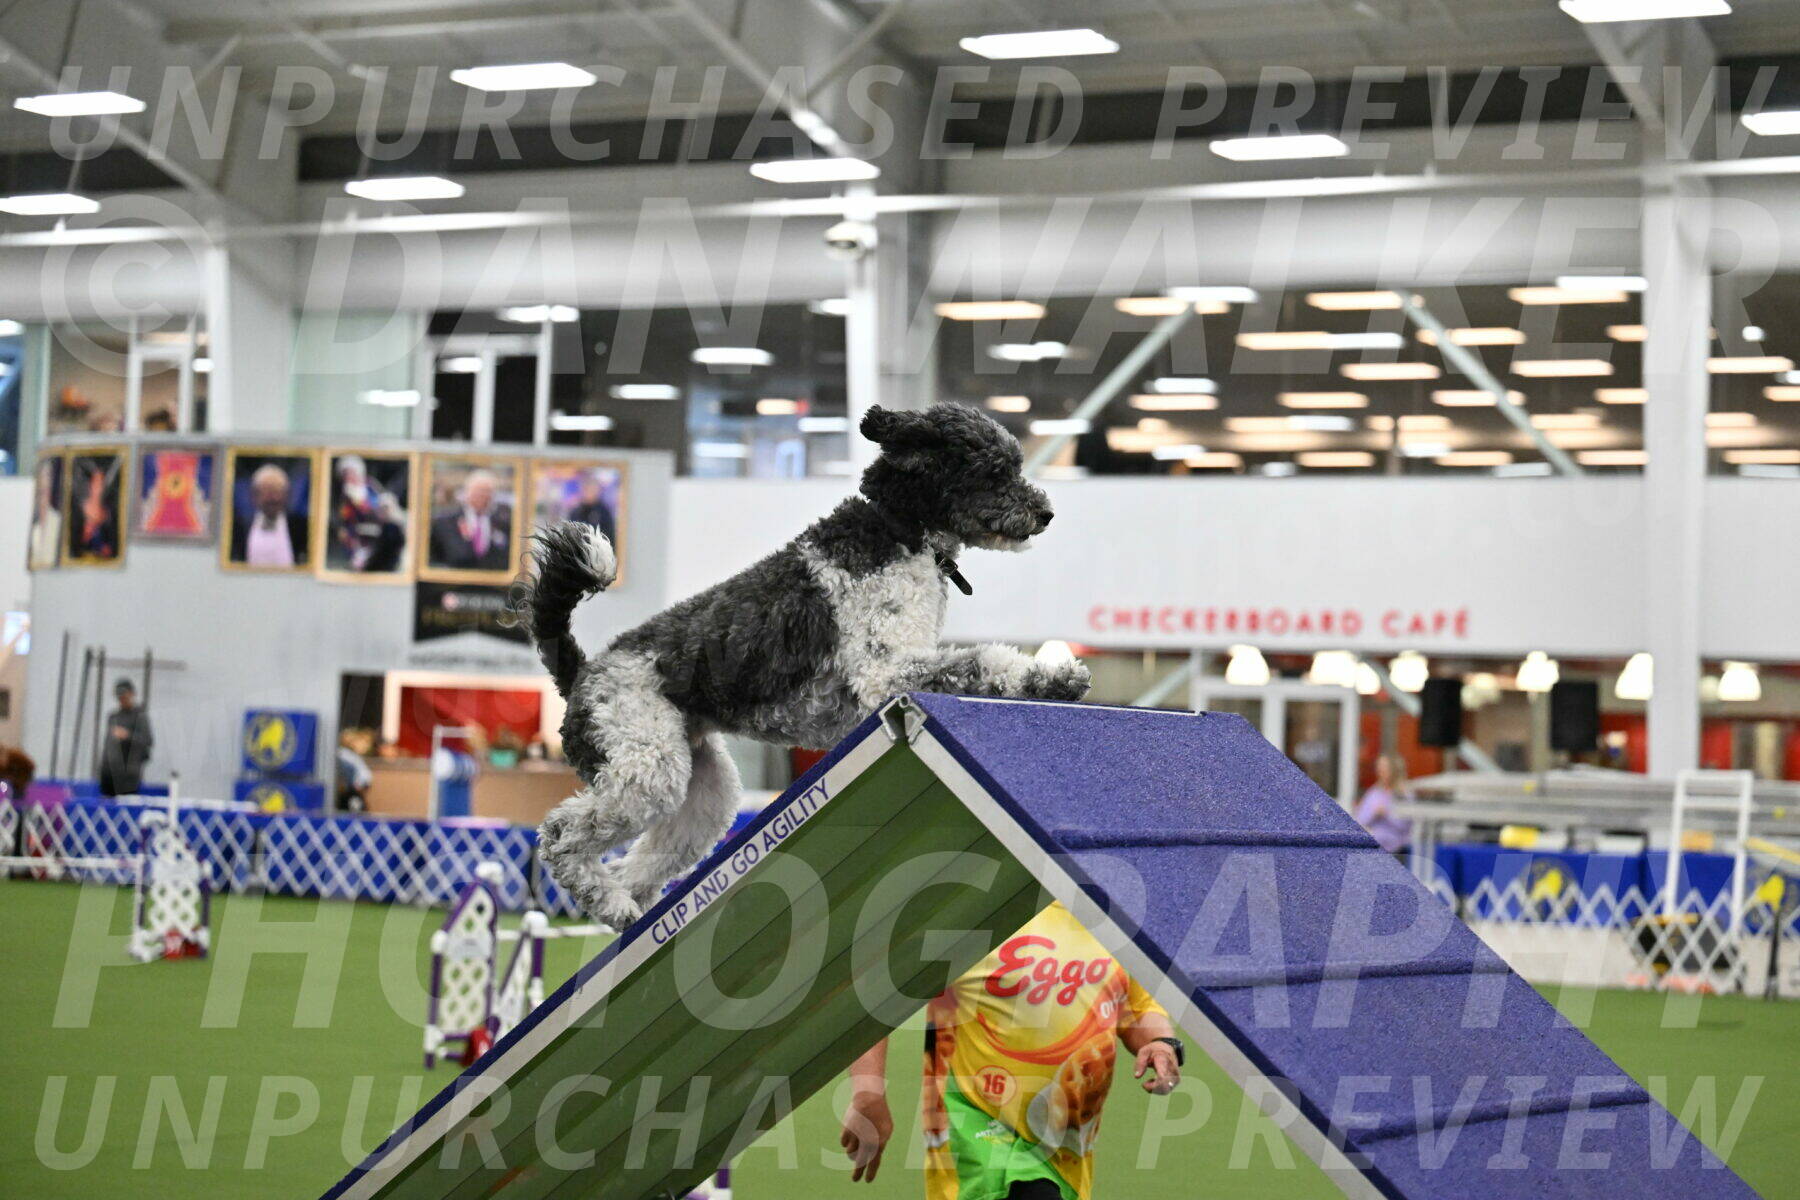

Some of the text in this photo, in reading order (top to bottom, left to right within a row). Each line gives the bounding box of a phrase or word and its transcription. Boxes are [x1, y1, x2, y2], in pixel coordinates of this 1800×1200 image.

[1088, 604, 1470, 637] CHECKERBOARD CAFÉ
[652, 777, 829, 944] CLIP AND GO AGILITY
[985, 935, 1112, 1006] Eggo
[983, 1073, 1005, 1095] 16
